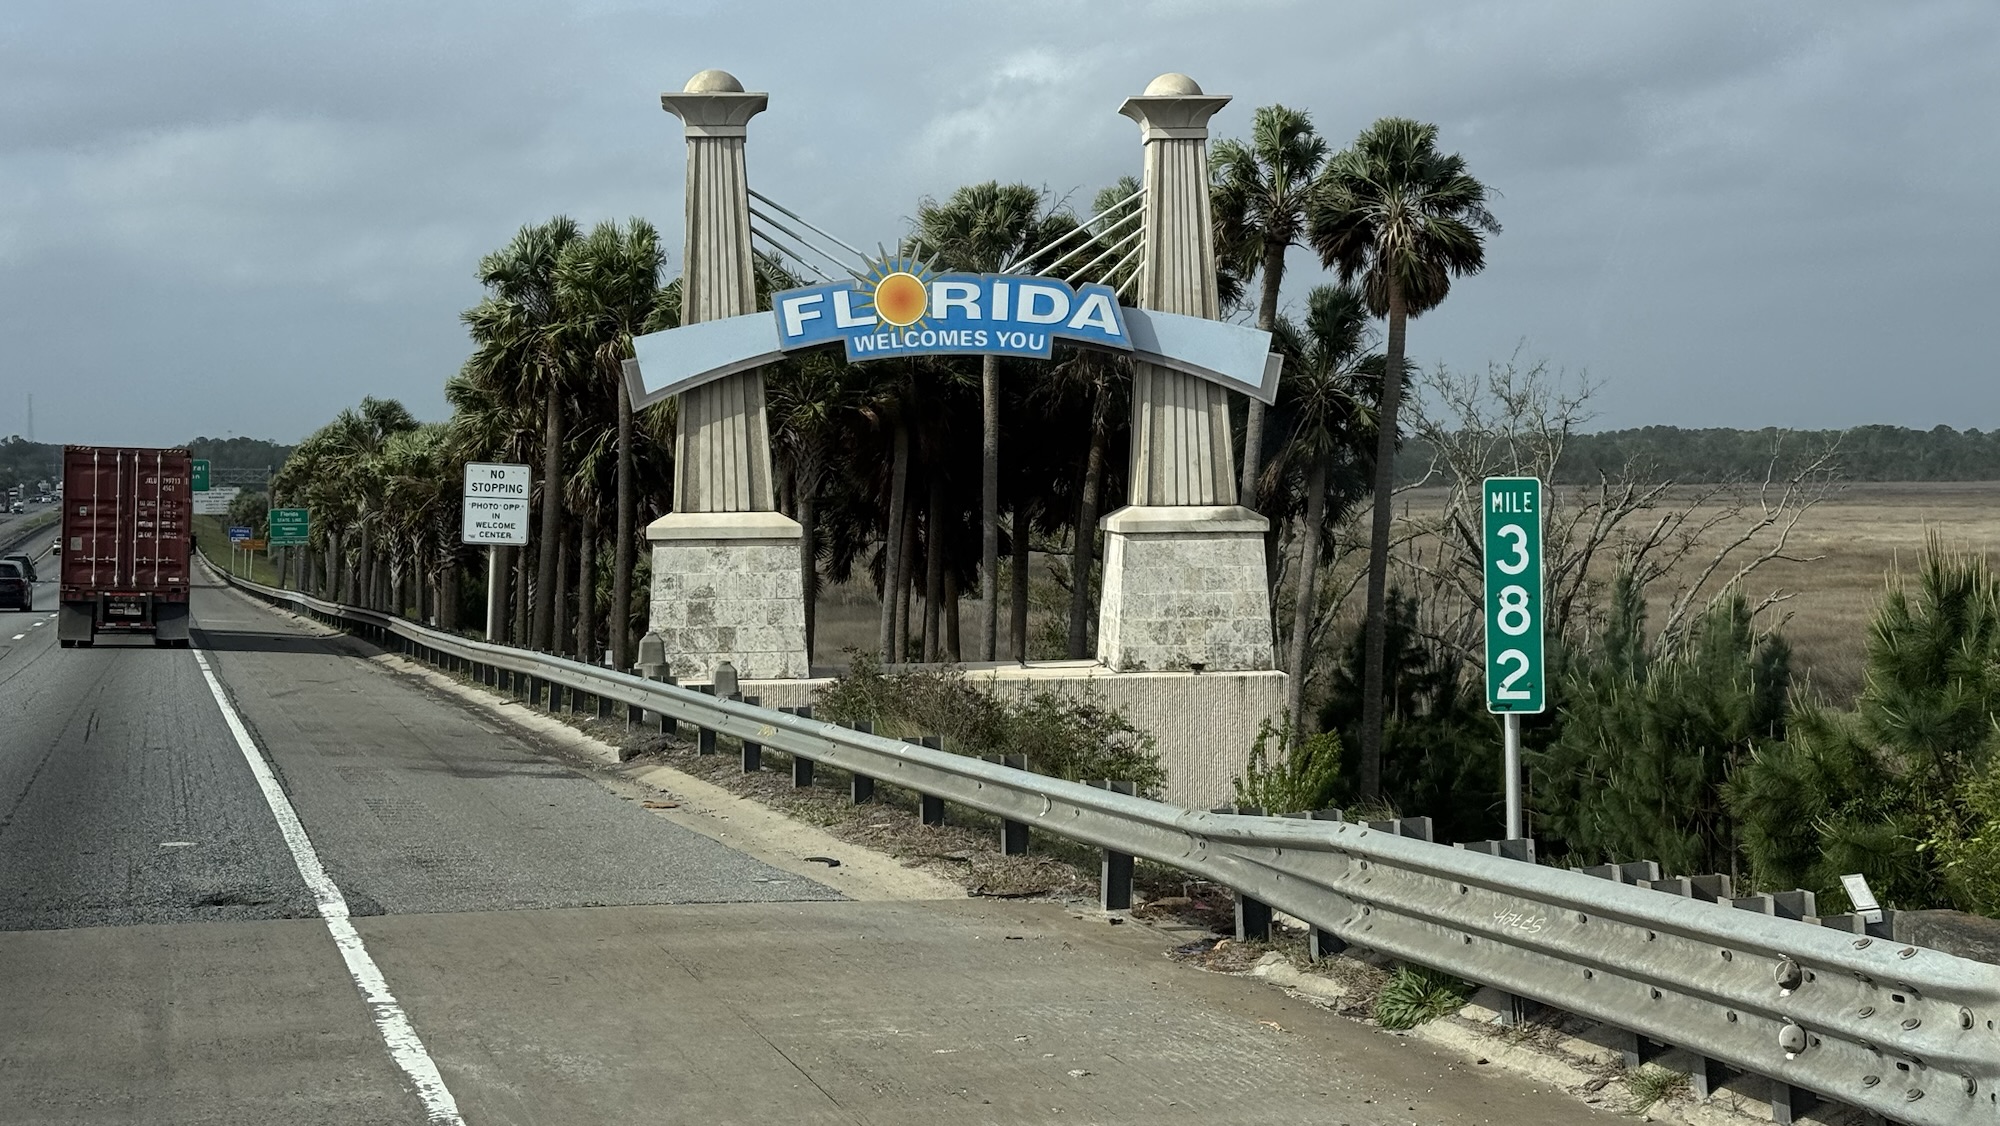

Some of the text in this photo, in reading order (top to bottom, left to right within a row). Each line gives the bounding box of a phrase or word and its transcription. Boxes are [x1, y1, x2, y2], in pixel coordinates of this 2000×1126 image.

[781, 272, 1121, 338] FLORIDA
[853, 330, 1046, 352] WELCOMES YOU
[490, 469, 505, 480] NO
[471, 482, 523, 494] STOPPING
[471, 502, 499, 510] PHOTO
[1491, 491, 1533, 513] MILE
[491, 512, 501, 520] IN
[475, 522, 516, 530] WELCOME
[478, 531, 513, 539] CENTER
